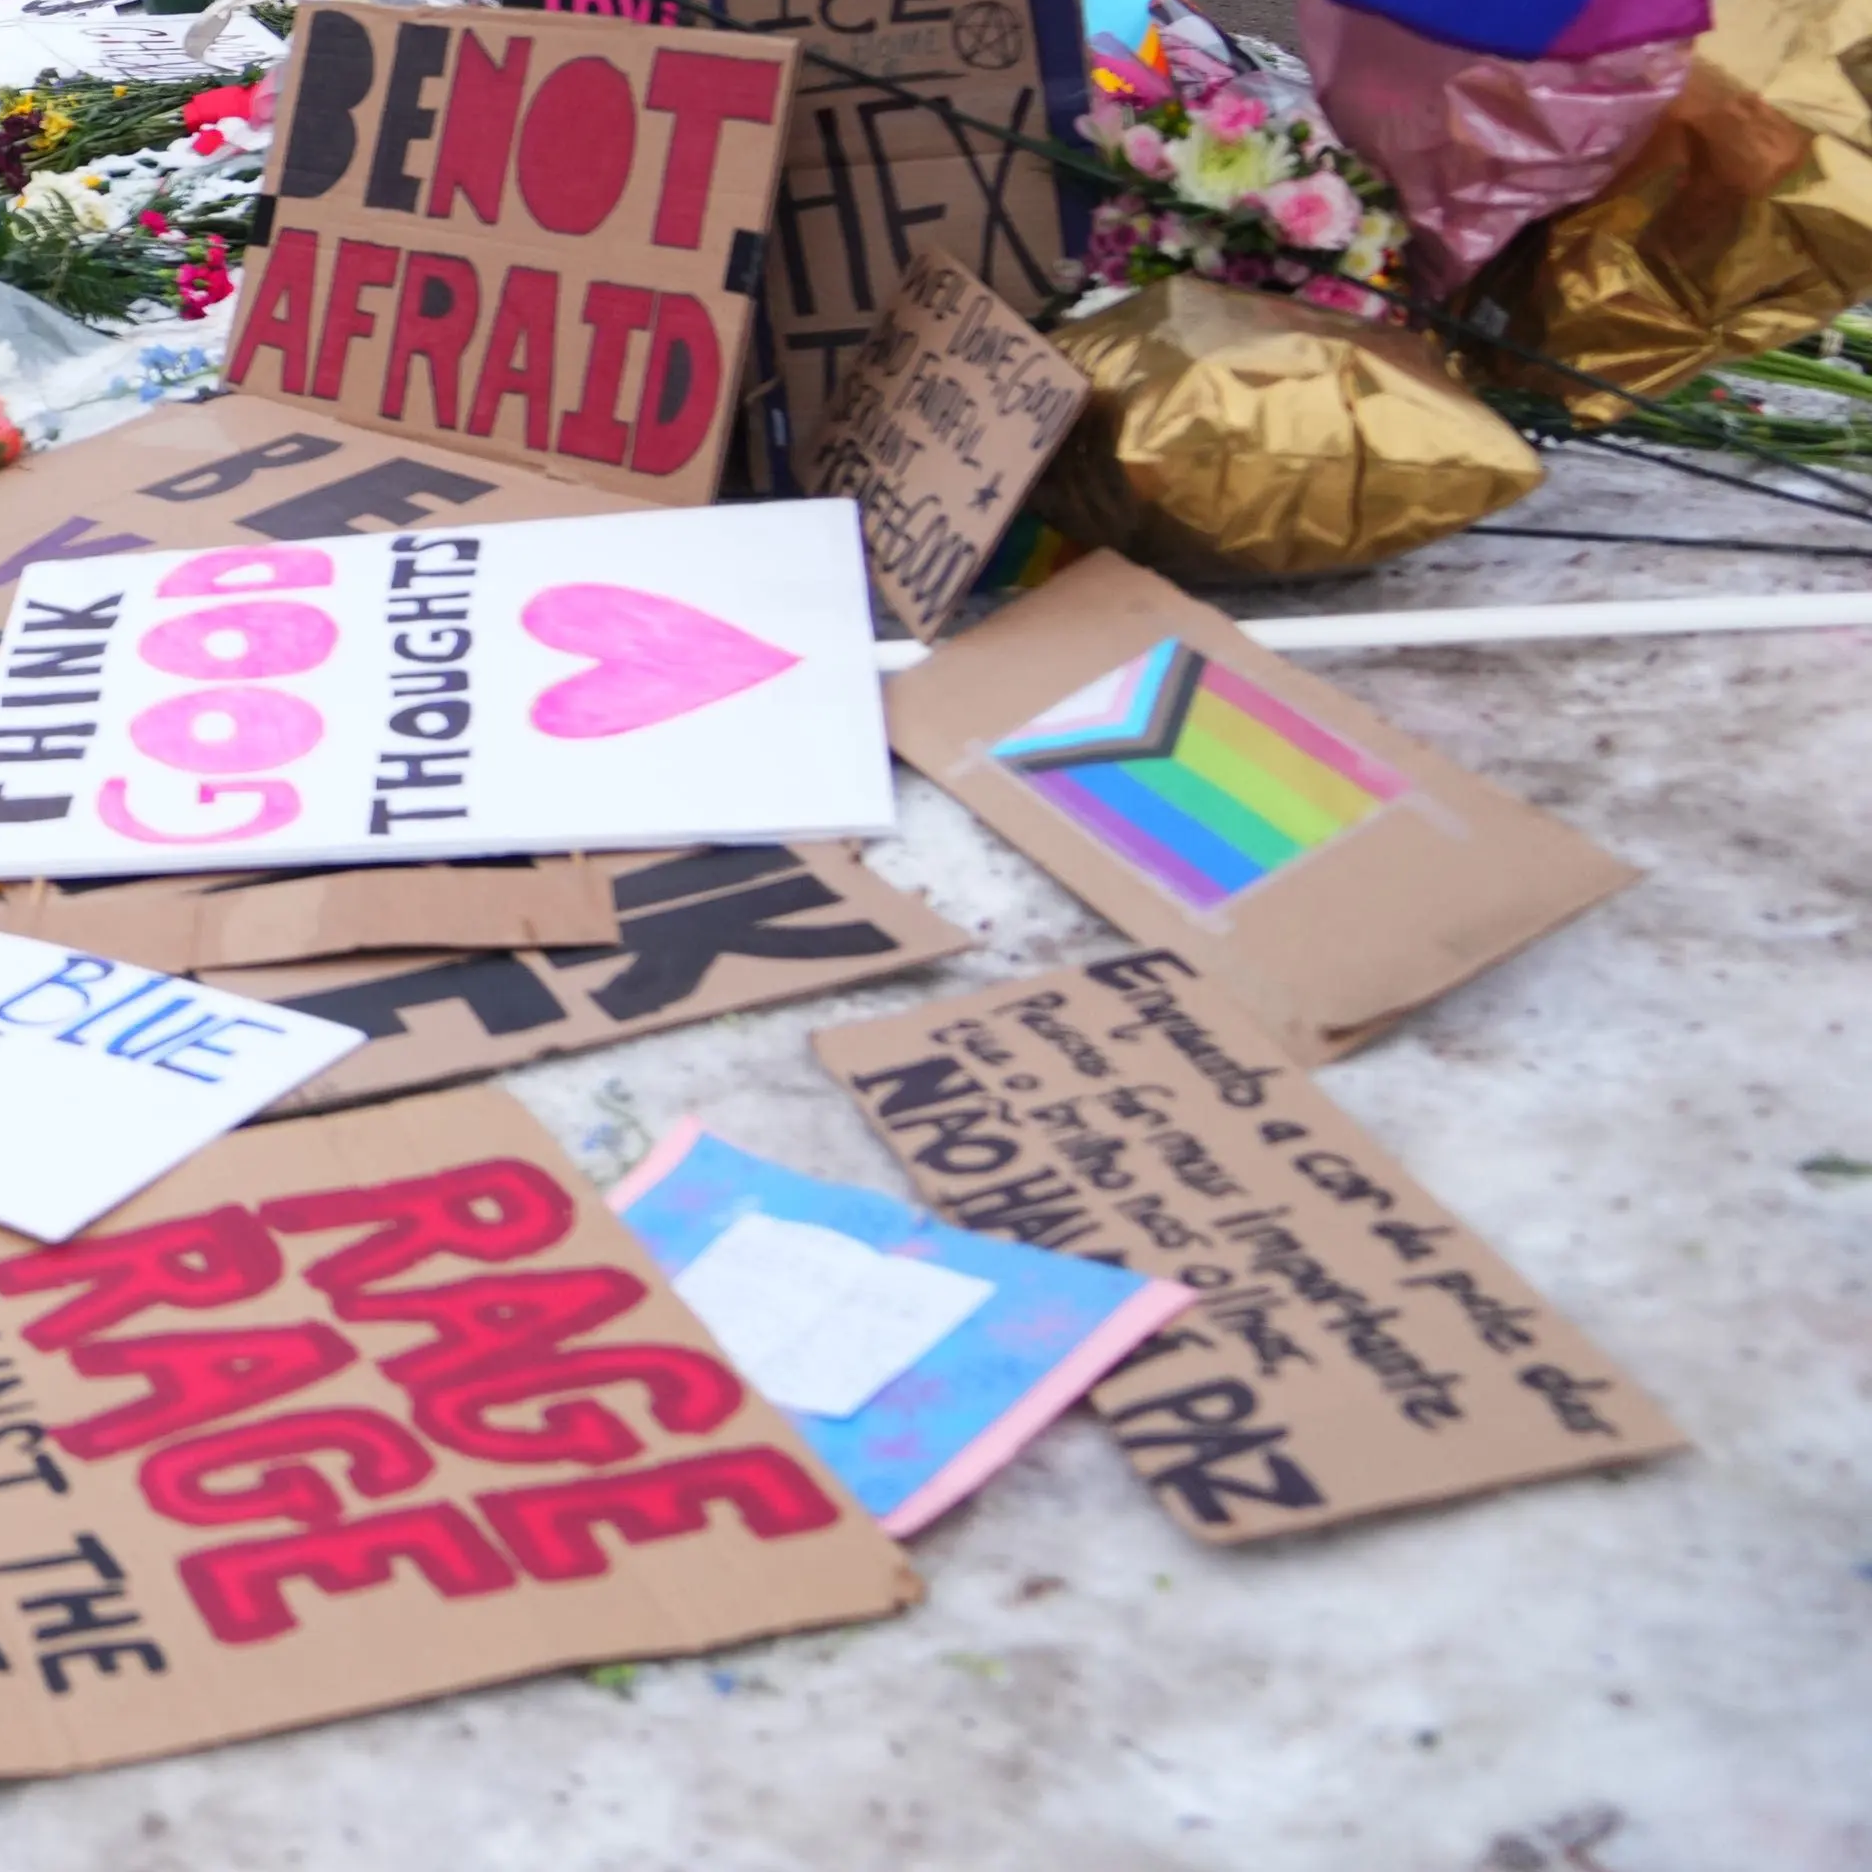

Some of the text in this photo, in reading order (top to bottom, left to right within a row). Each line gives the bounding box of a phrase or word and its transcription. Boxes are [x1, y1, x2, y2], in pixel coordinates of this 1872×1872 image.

[278, 9, 783, 251] BE NOT
[768, 87, 1062, 318] HEX
[227, 227, 722, 476] AFRAID
[97, 544, 341, 845] GOOD
[368, 536, 482, 834] THOUGHTS
[261, 1157, 841, 1585] RAGE
[849, 1052, 1023, 1178] NÃO
[1107, 1375, 1328, 1527] PAZ
